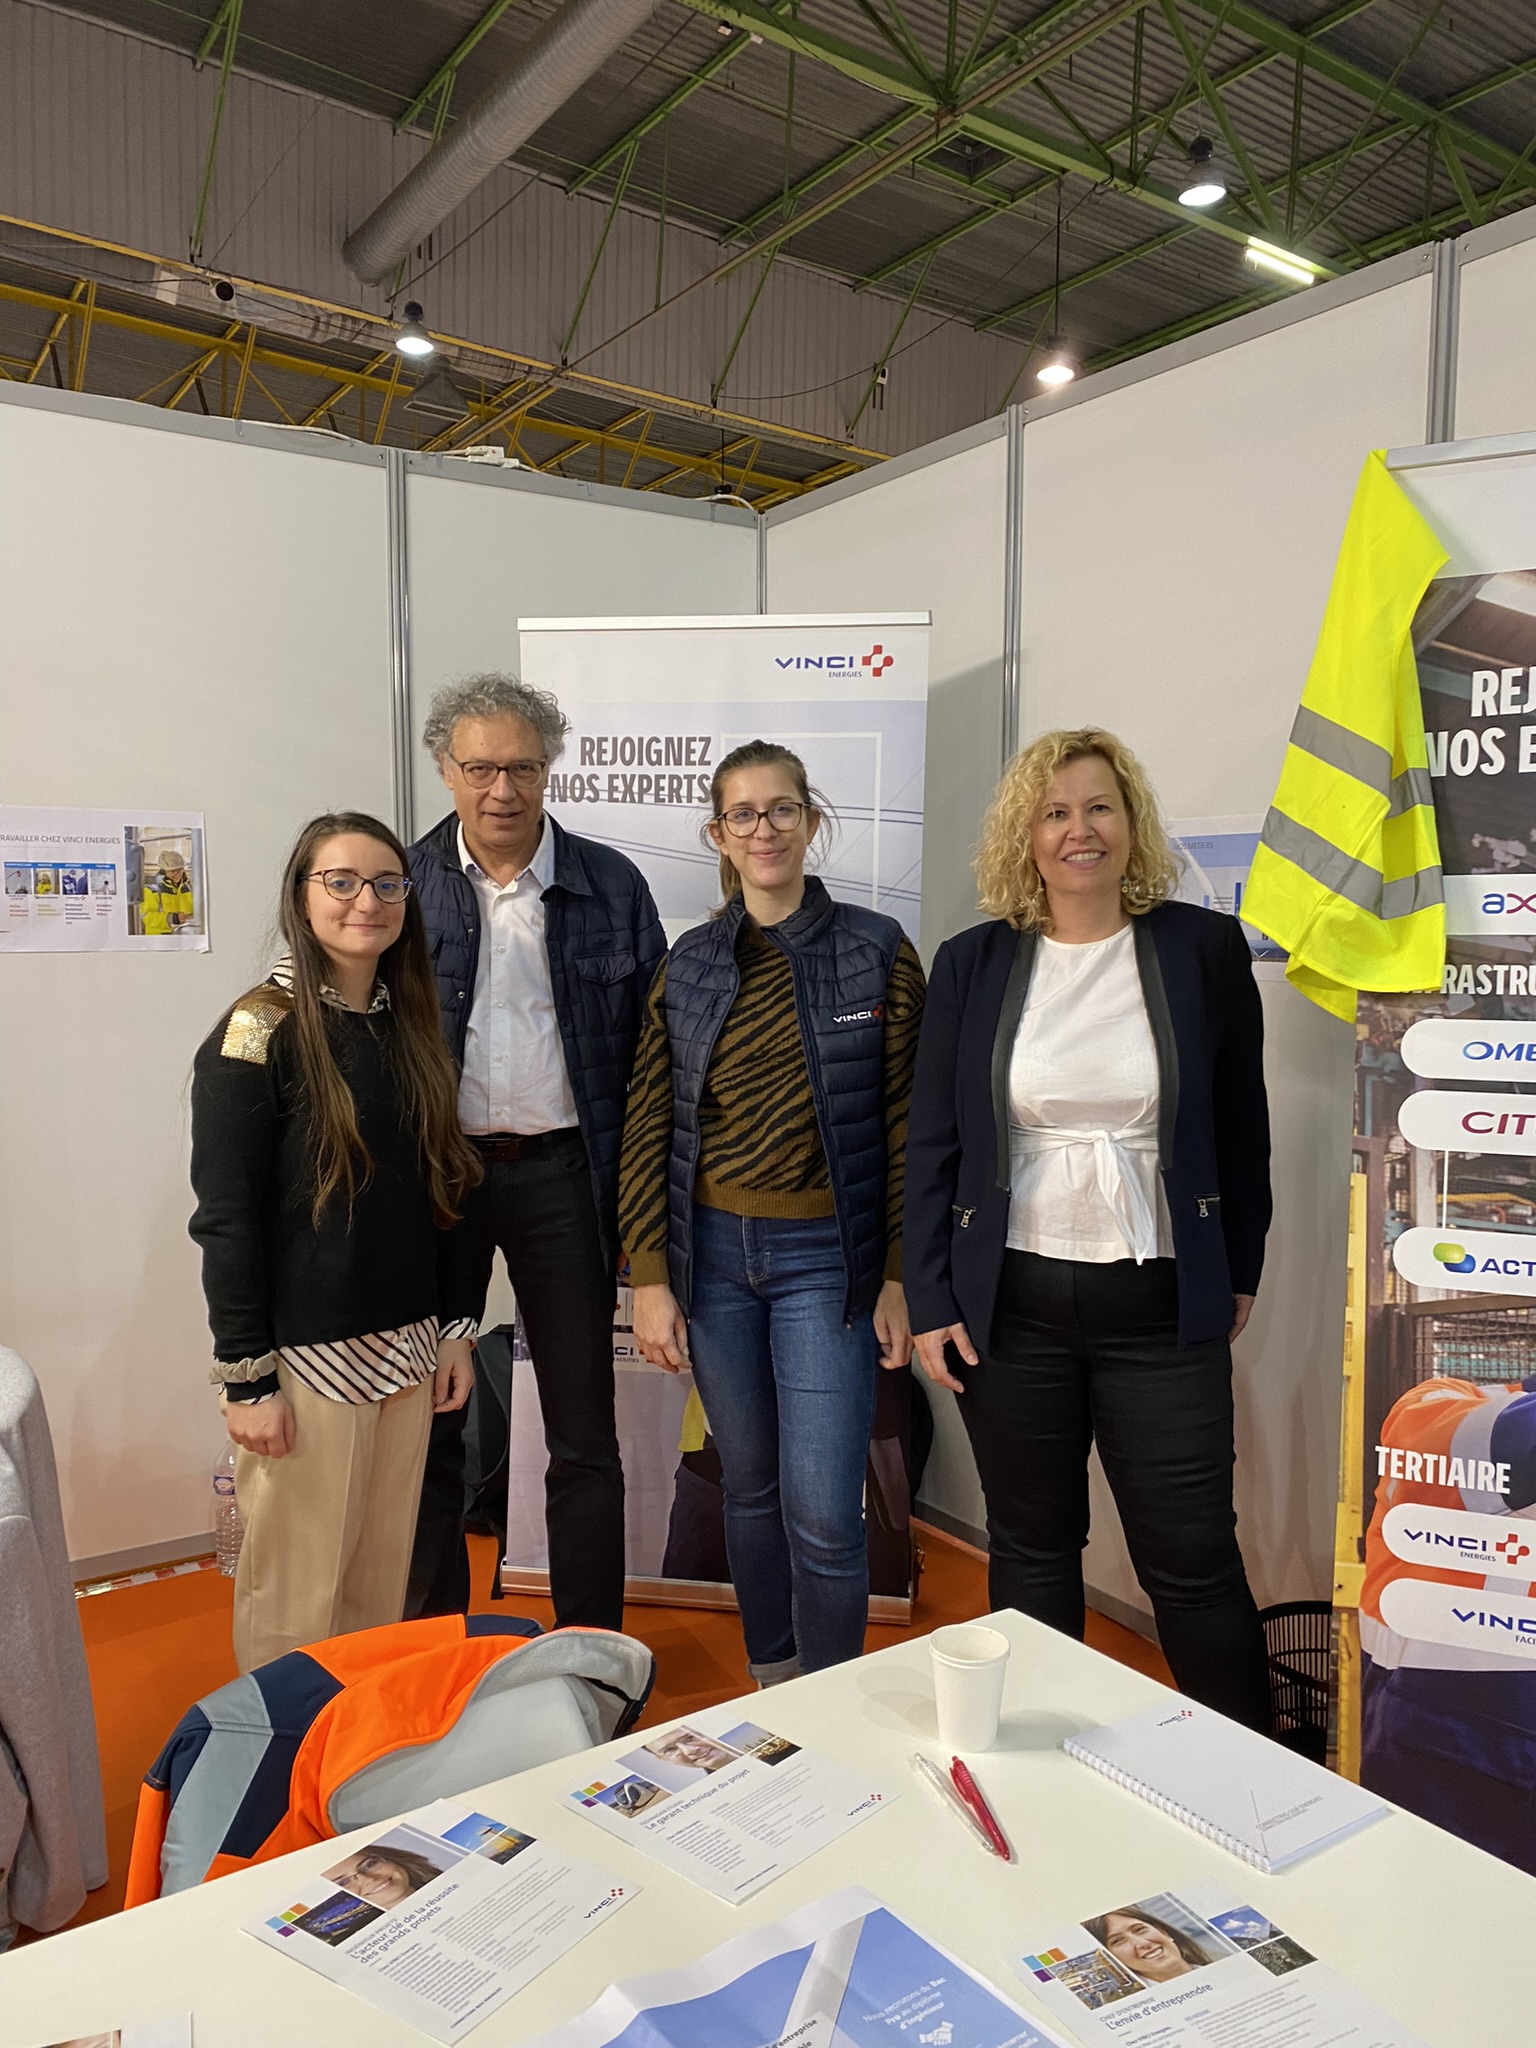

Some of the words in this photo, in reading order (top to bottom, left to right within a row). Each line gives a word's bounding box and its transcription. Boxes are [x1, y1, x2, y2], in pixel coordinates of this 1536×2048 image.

[775, 656, 854, 669] VINCI
[1471, 666, 1536, 717] REJ
[580, 736, 712, 766] REJOIGNEZ
[1424, 727, 1506, 777] NOS
[550, 773, 600, 803] NOS
[607, 773, 713, 804] EXPERTS
[41, 835, 61, 843] CHEZ
[62, 836, 82, 844] VINCI
[1402, 964, 1536, 995] RASTR
[833, 1010, 871, 1023] VINCI
[1375, 1445, 1511, 1494] TERTIAIRE
[1403, 1528, 1487, 1551] VINCI
[1460, 1551, 1496, 1562] ENERGIES
[1451, 1608, 1536, 1634] VINC
[644, 1822, 658, 1831] Le
[657, 1808, 682, 1825] garant
[681, 1786, 718, 1811] technique
[718, 1781, 729, 1789] du
[728, 1768, 751, 1784] projet
[847, 1800, 872, 1816] VINCI
[350, 1933, 389, 1960] L'acteur
[388, 1922, 403, 1935] clé
[403, 1913, 417, 1924] de
[414, 1907, 426, 1916] la
[425, 1883, 460, 1908] réussite
[584, 1897, 612, 1919] VINCI
[360, 1951, 379, 1964] des
[378, 1929, 411, 1953] grands
[410, 1906, 442, 1930] projets
[862, 2011, 886, 2023] Nous
[920, 1984, 931, 1993] du
[929, 1977, 946, 1988] Bac
[1105, 2012, 1143, 2031] L'envie
[1142, 1983, 1213, 2016] d'entreprendre
[884, 2014, 901, 2026] Pro
[901, 2008, 912, 2017] au
[1099, 2012, 1115, 2023] CHEF
